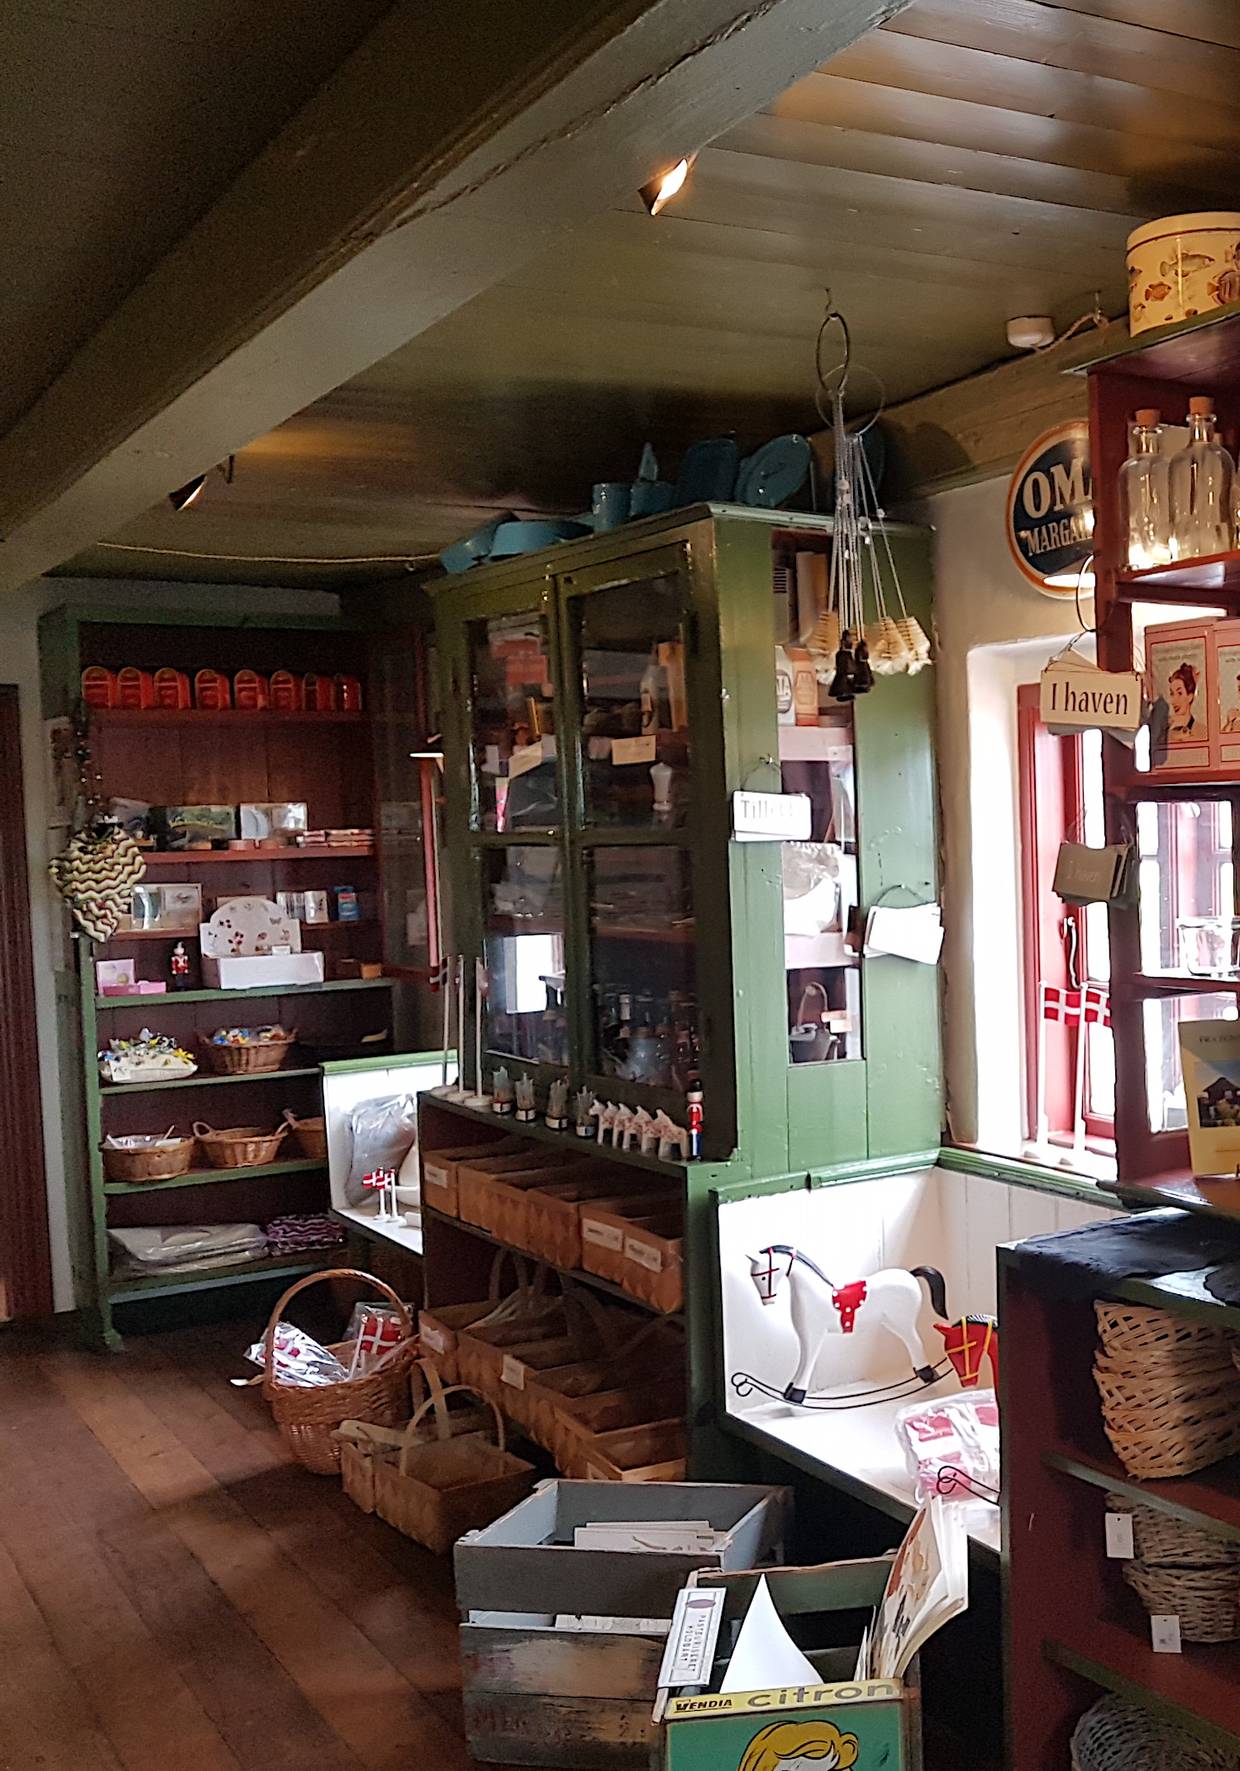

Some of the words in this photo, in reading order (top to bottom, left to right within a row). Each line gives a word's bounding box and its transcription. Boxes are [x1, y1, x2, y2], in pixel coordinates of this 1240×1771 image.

[1022, 457, 1093, 519] OM
[1050, 682, 1058, 711] I
[1064, 681, 1128, 715] haven
[747, 1681, 893, 1708] citron
